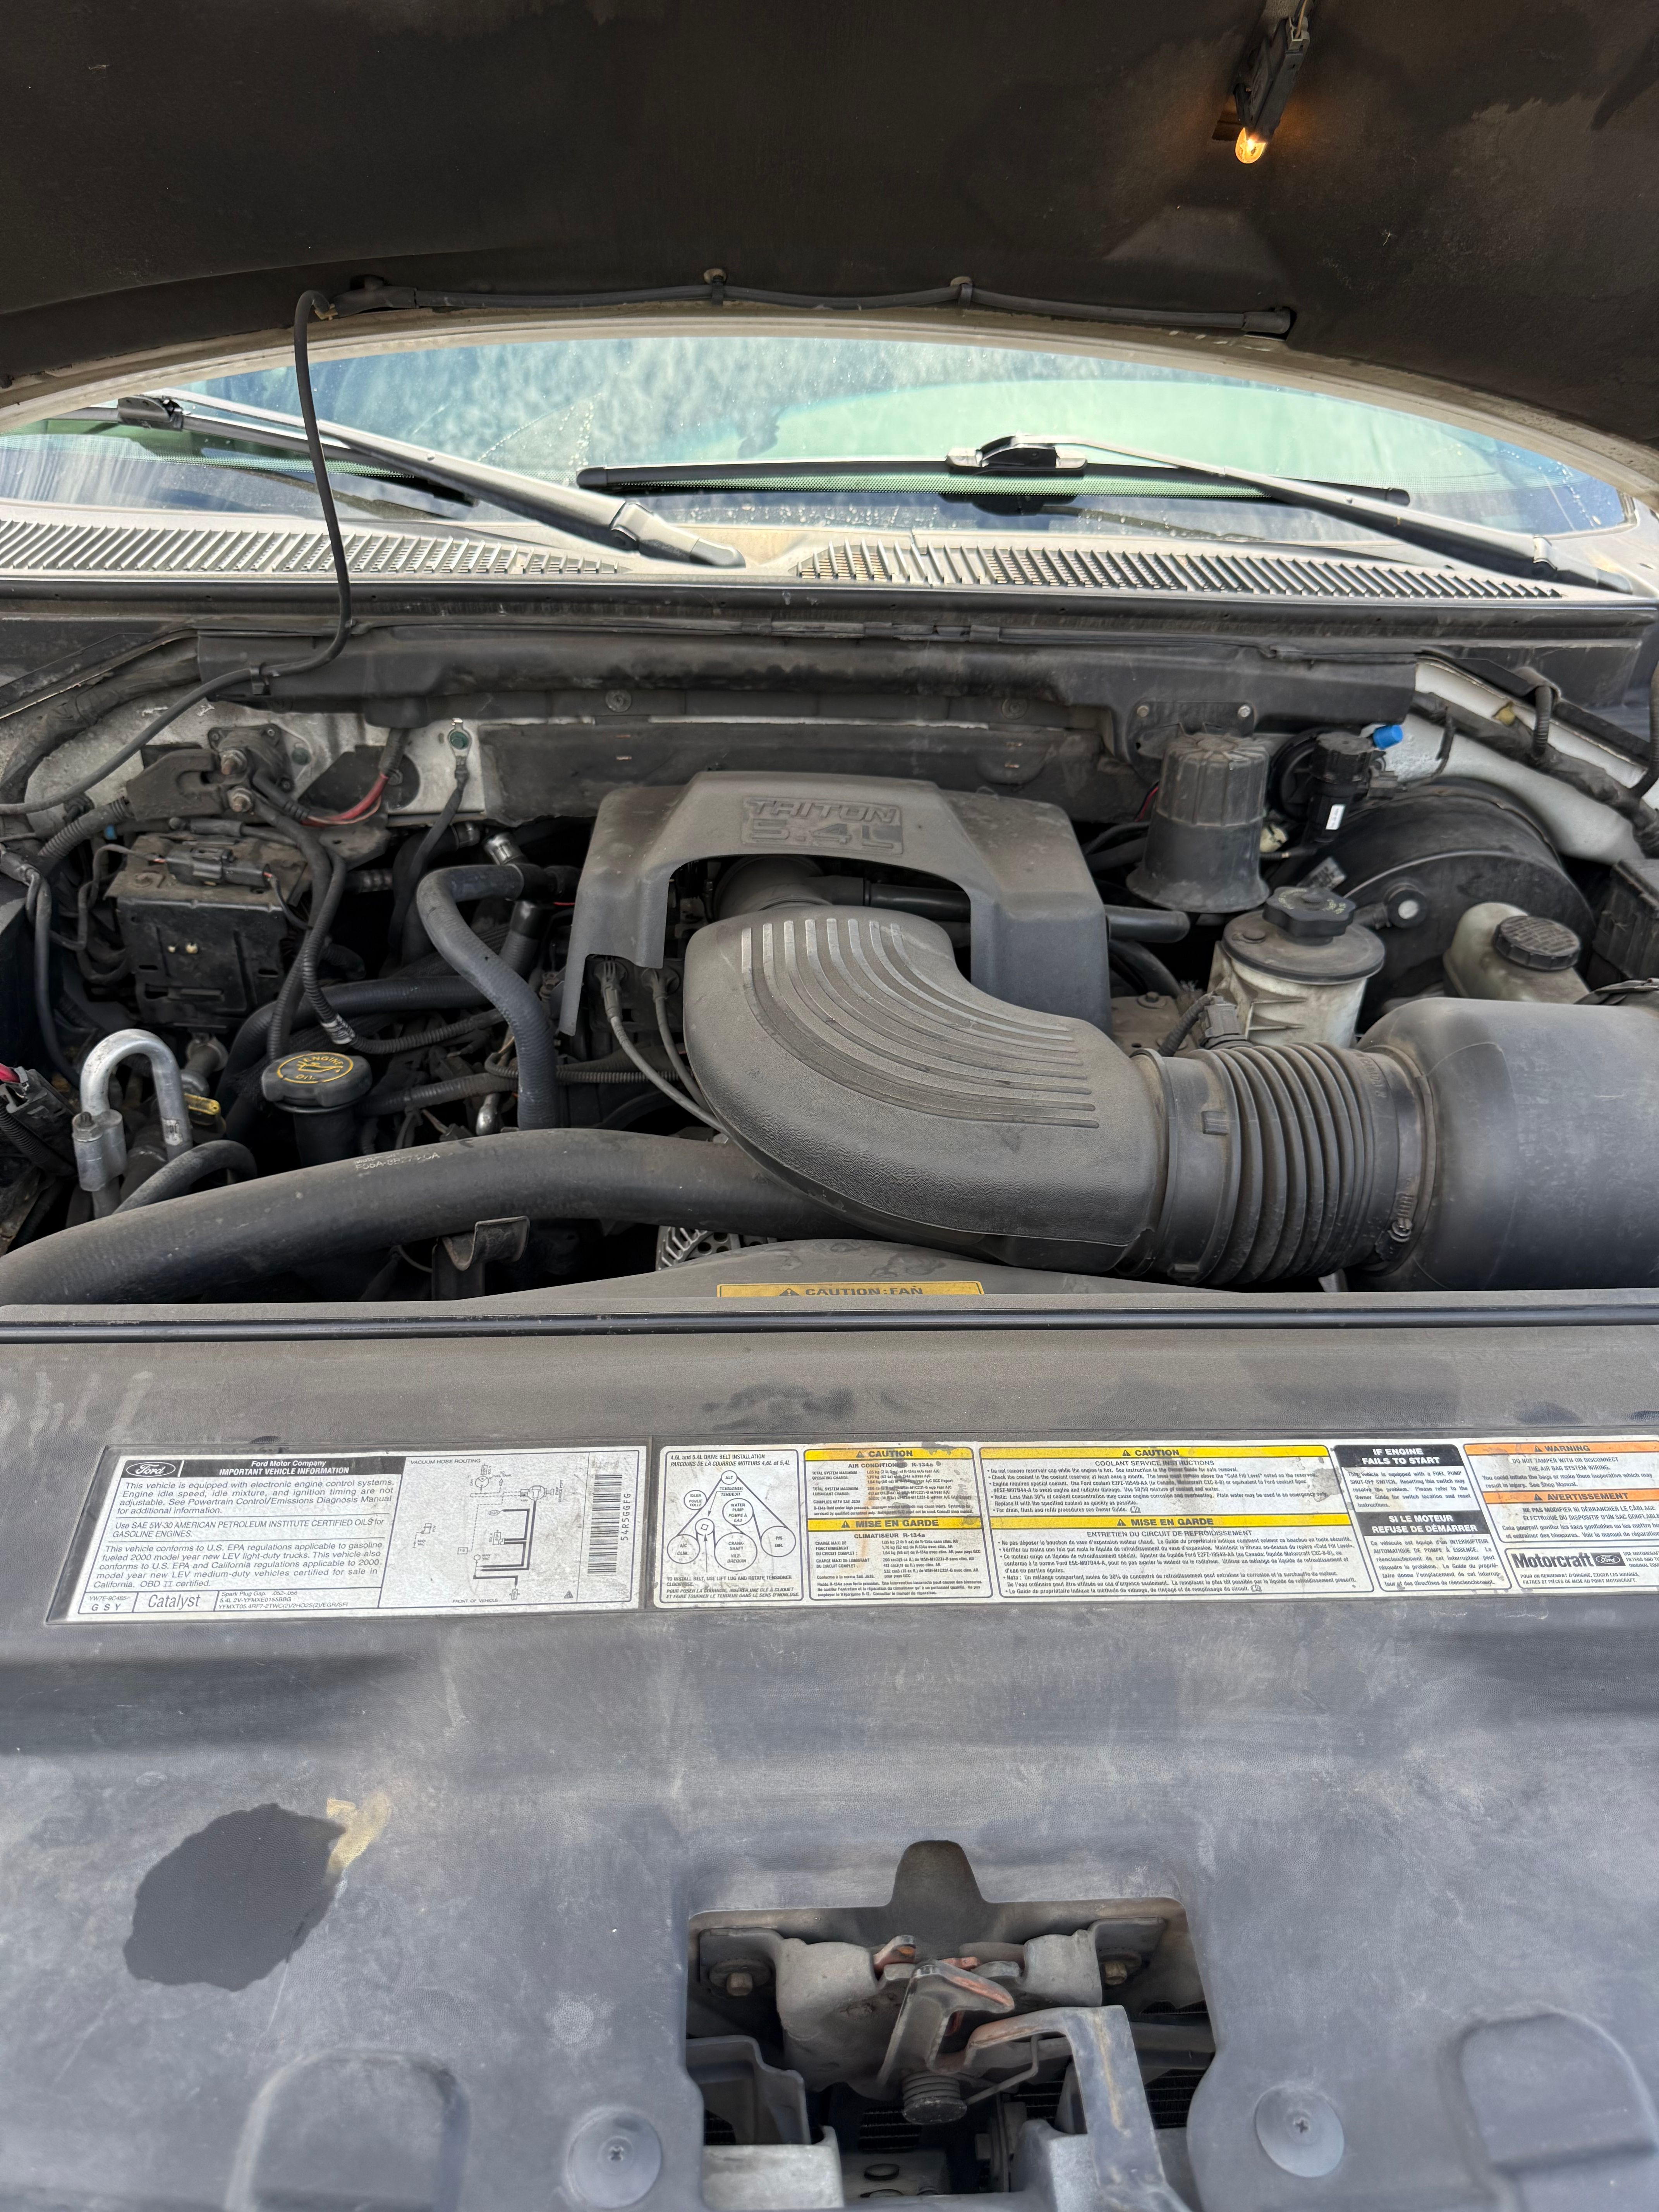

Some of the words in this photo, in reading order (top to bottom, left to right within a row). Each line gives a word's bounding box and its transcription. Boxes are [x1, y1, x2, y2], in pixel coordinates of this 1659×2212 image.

[747, 799, 899, 823] TRITON
[750, 818, 895, 849] 5.4L
[303, 1056, 344, 1065] ENGINE
[868, 1449, 913, 1458] CAUTION
[1134, 1449, 1180, 1457] CAUTION
[135, 1464, 166, 1475] Ford
[188, 1481, 228, 1490] equipped
[294, 1480, 323, 1489] engine
[357, 1479, 394, 1488] systems.
[122, 1490, 153, 1499] Engine
[177, 1490, 207, 1499] speed,
[293, 1489, 325, 1497] ignition
[330, 1487, 357, 1496] timing
[1547, 1492, 1628, 1501] AVERTISSEMENT
[119, 1498, 165, 1507] adjustable.
[236, 1496, 314, 1505] Control/Emissions
[316, 1496, 358, 1505] Diagnosis
[361, 1495, 392, 1504] Manual
[620, 1493, 631, 1540] 54R5GGFG
[1413, 1514, 1454, 1522] MOTEUR
[311, 1519, 353, 1527] CERTIFIED
[884, 1519, 899, 1527] EN
[1371, 1525, 1409, 1534] REFUSE
[1424, 1523, 1478, 1532] DÉMARRER
[247, 1543, 292, 1552] regulations
[294, 1542, 336, 1551] applicable
[348, 1541, 383, 1551] gasoline
[1511, 1552, 1594, 1568] Motorcraft
[148, 1594, 201, 1610] Catalyst
